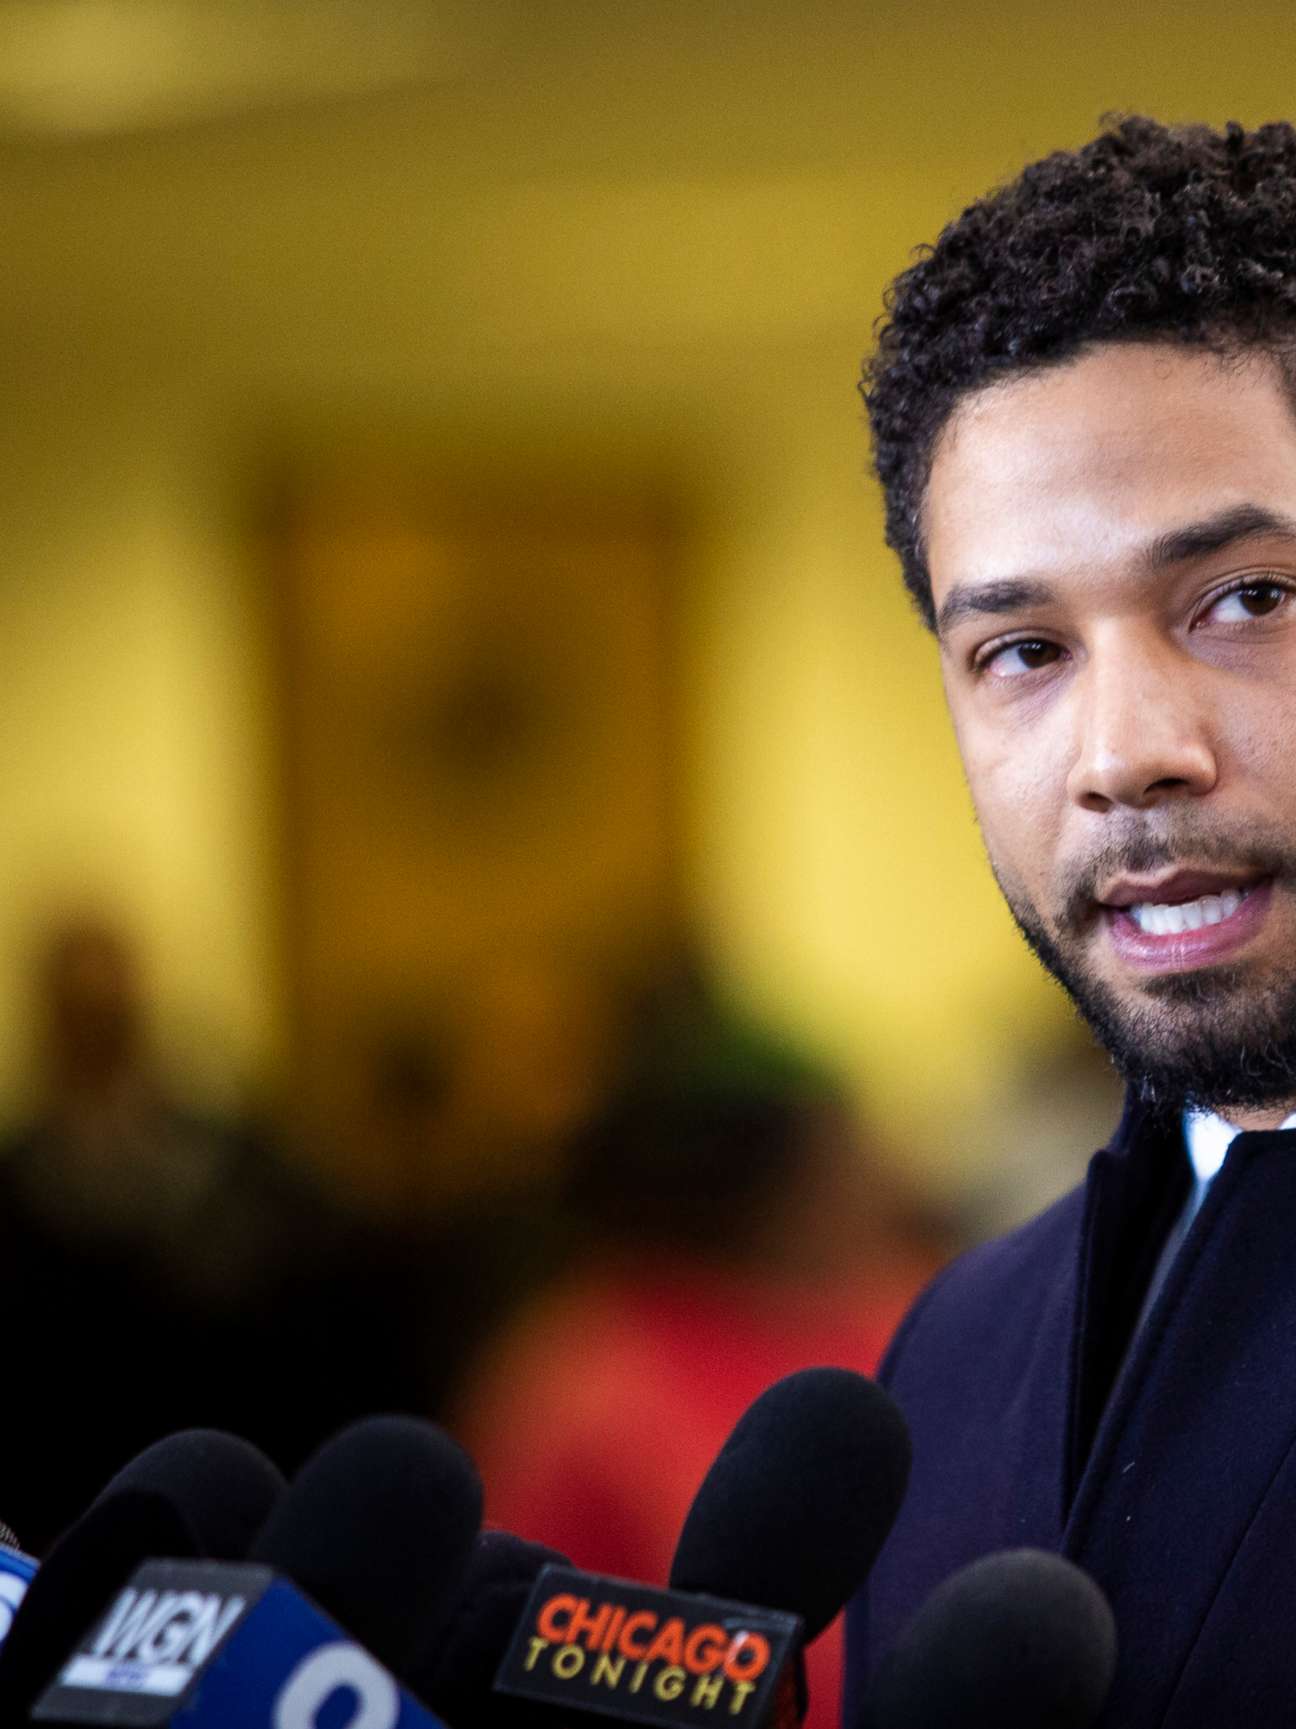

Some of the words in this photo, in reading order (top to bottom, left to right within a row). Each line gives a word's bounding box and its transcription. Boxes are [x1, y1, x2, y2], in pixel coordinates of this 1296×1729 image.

[91, 1588, 246, 1666] WGN
[538, 1594, 771, 1682] CHICAGO
[525, 1638, 756, 1715] TONIGHT
